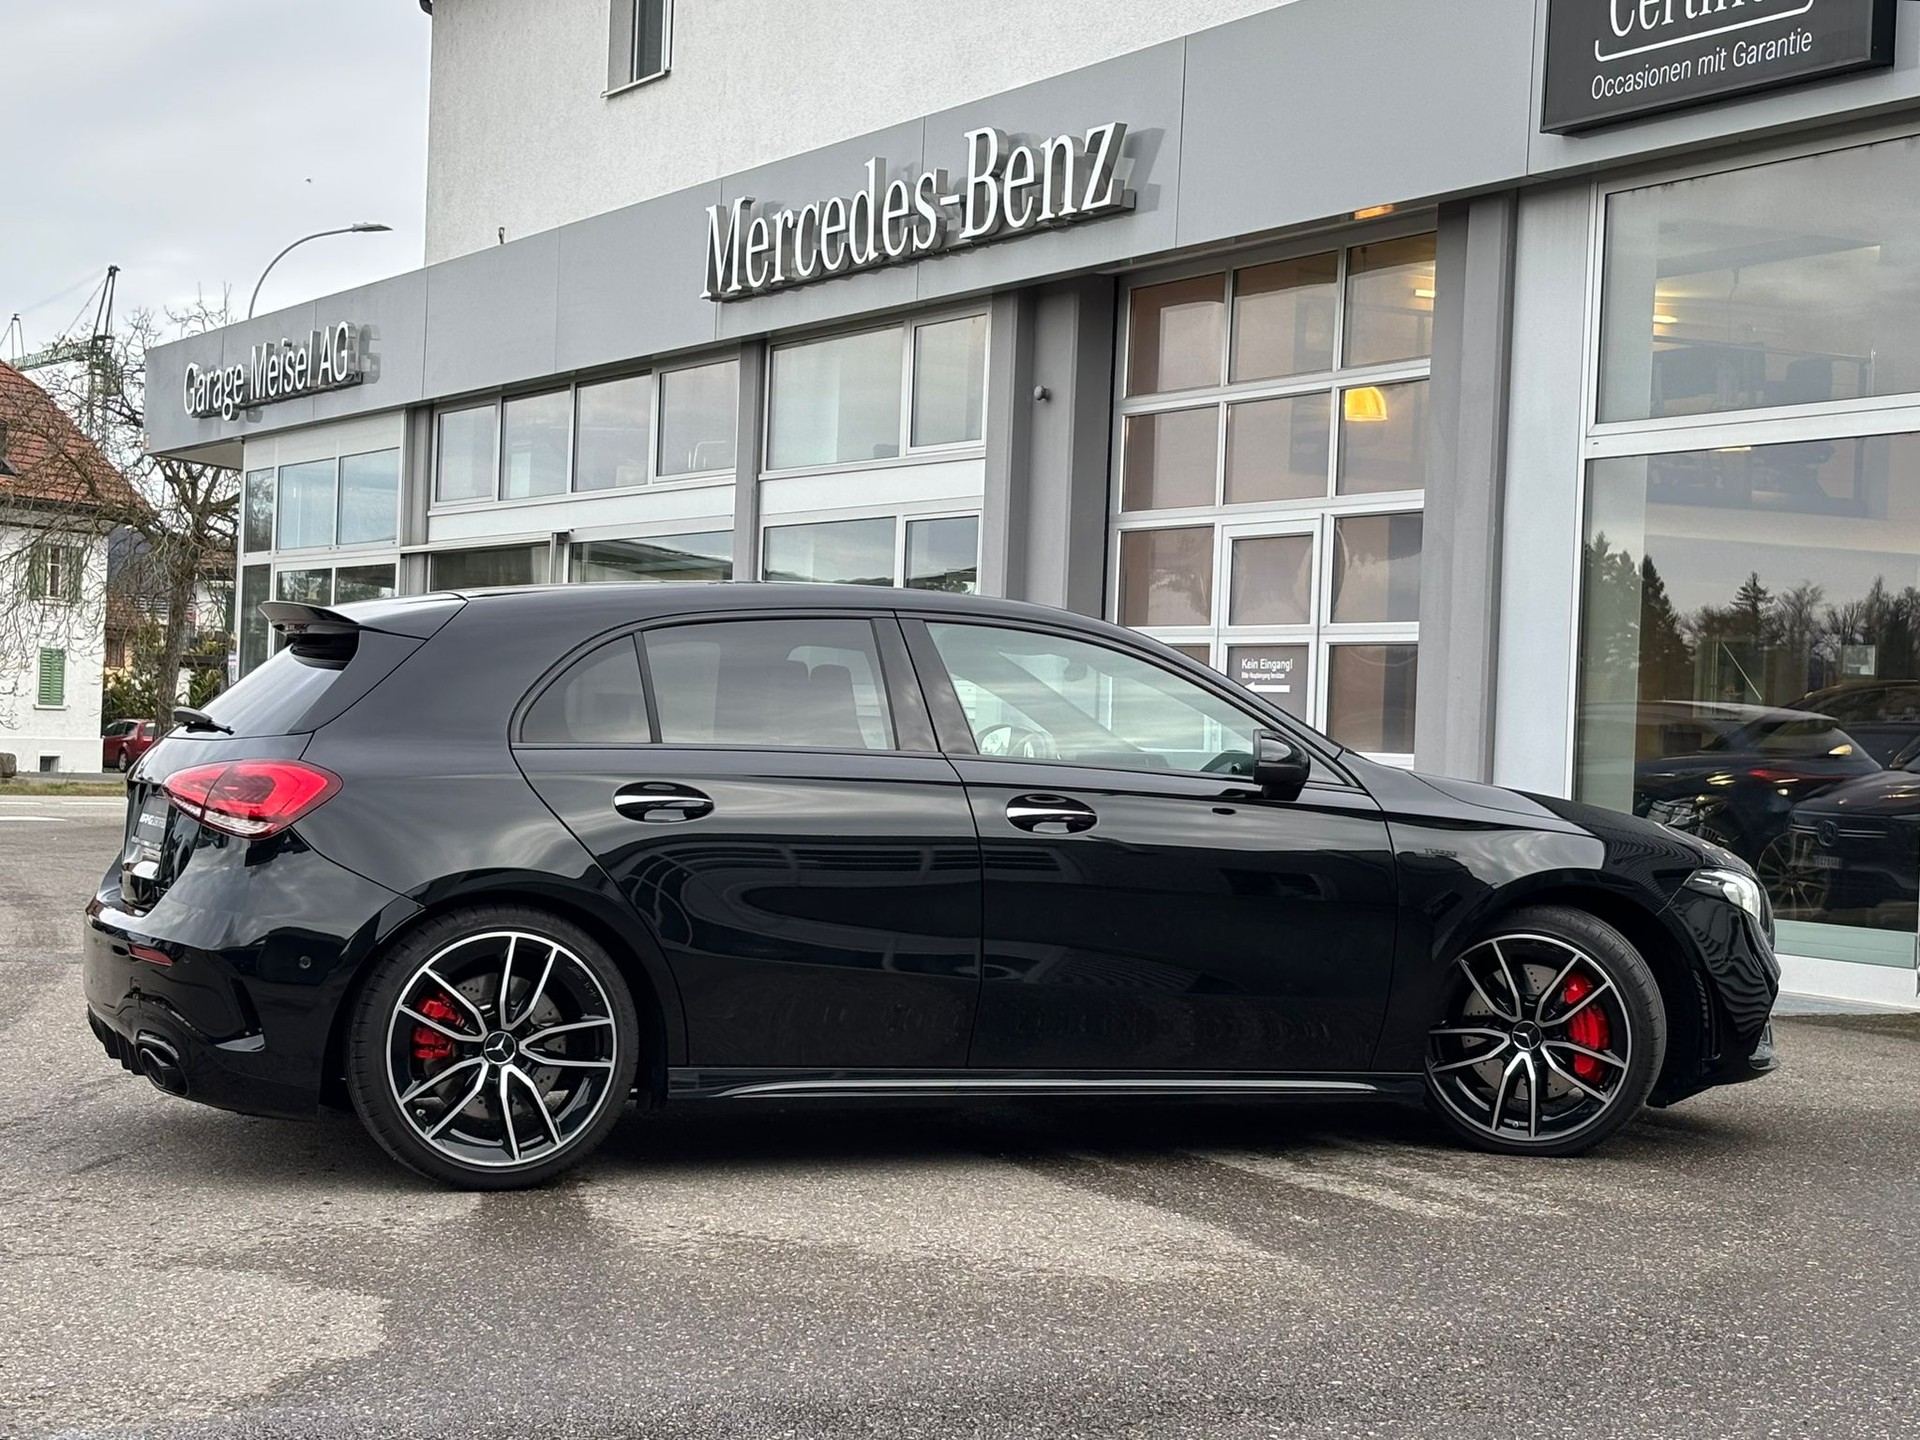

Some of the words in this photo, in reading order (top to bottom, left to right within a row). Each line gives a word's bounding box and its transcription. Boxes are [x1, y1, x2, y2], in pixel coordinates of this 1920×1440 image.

[1592, 60, 1691, 99] Occasionen
[1698, 48, 1726, 77] mit
[1732, 29, 1812, 68] Garantie
[700, 121, 1126, 299] Mercedes-Benz
[183, 362, 244, 421] Garage
[250, 330, 313, 400] Meisel
[317, 321, 348, 385] AG
[1241, 658, 1259, 670] Kein
[1260, 658, 1293, 672] Eingang!
